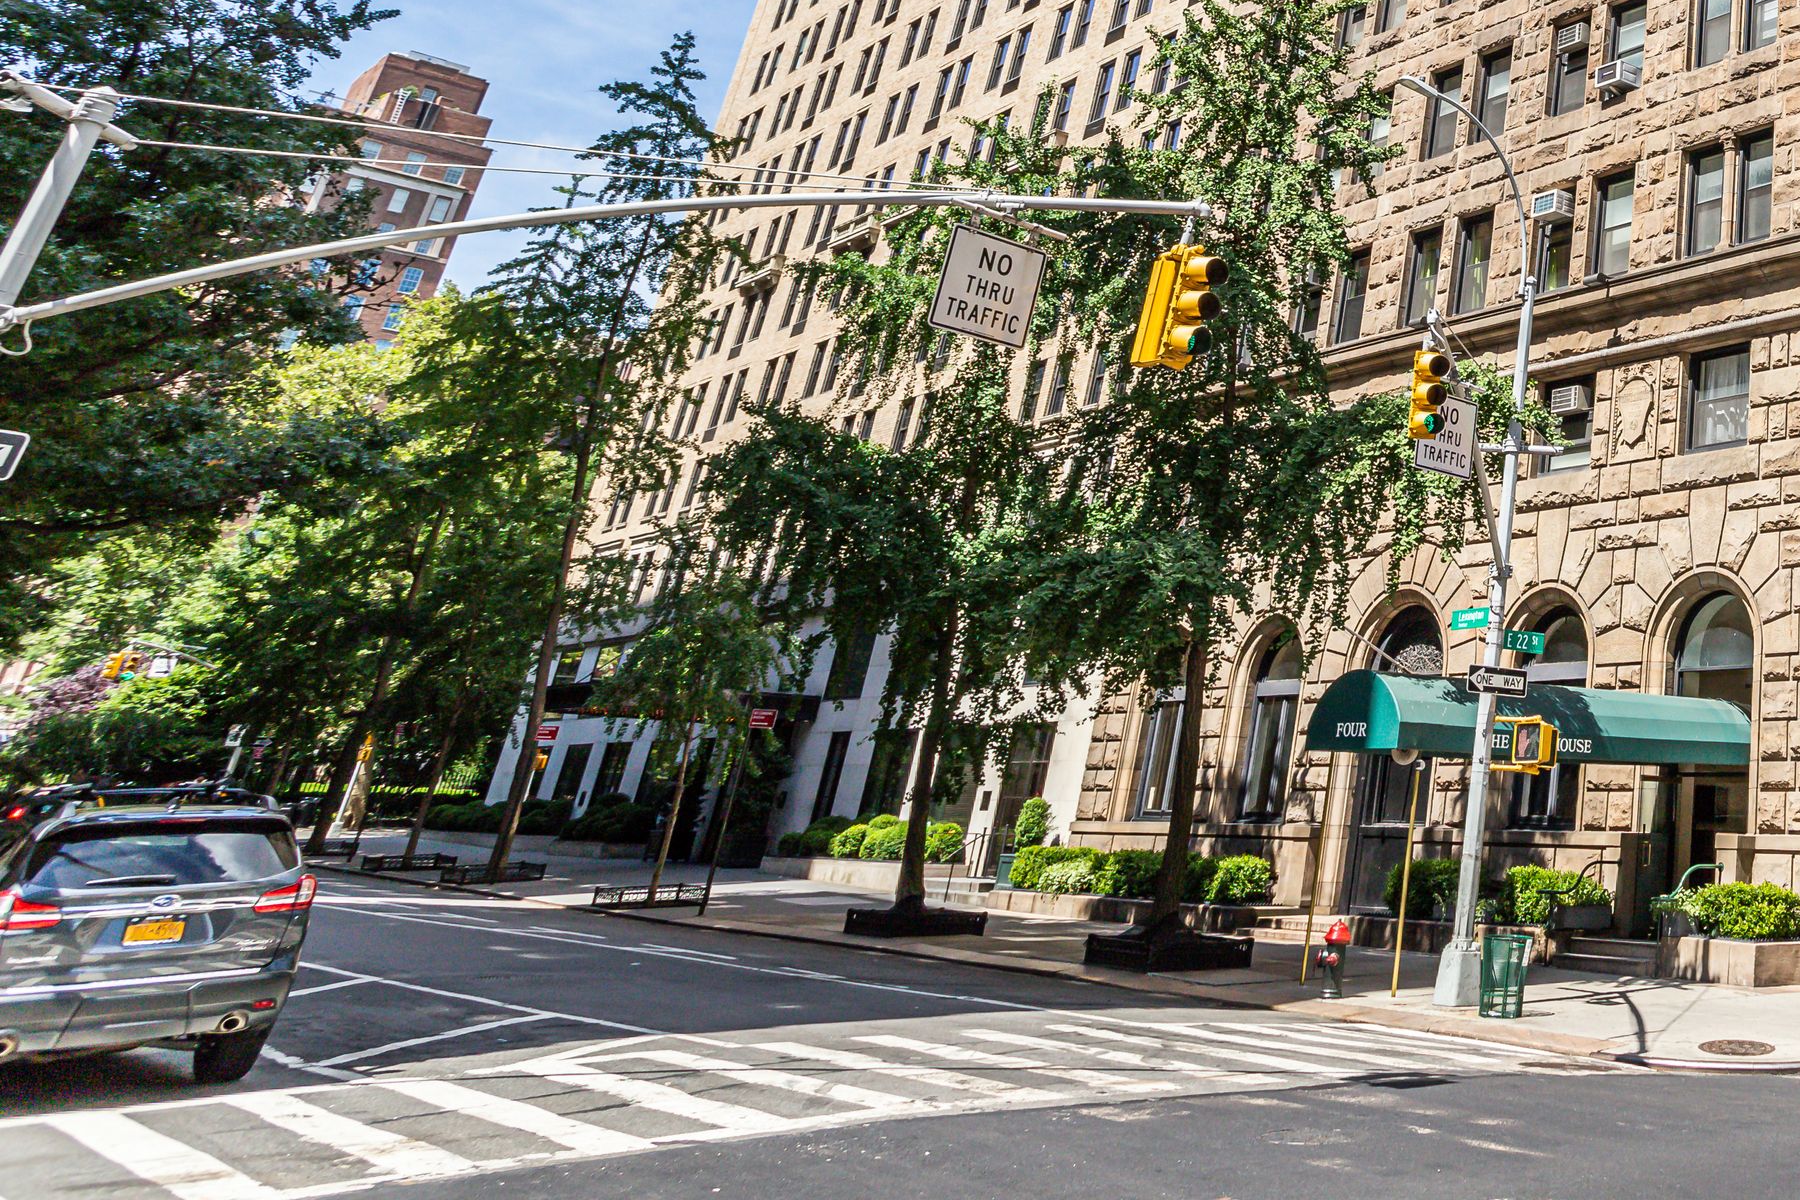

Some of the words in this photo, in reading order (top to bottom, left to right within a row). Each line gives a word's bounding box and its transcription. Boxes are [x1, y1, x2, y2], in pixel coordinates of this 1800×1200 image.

[978, 247, 1013, 276] NO
[966, 274, 1015, 305] THRU
[946, 296, 1020, 334] TRAFFIC
[1440, 405, 1459, 425] NO
[1439, 429, 1462, 447] HRU
[1423, 443, 1466, 469] TRAFFIC
[1458, 610, 1485, 623] Lexington
[1507, 633, 1513, 648] E
[1516, 634, 1529, 650] 22
[1531, 635, 1539, 645] St
[1475, 673, 1494, 686] ONE
[1503, 676, 1522, 688] WAY
[1335, 722, 1367, 738] FOUR
[1491, 734, 1510, 749] HE
